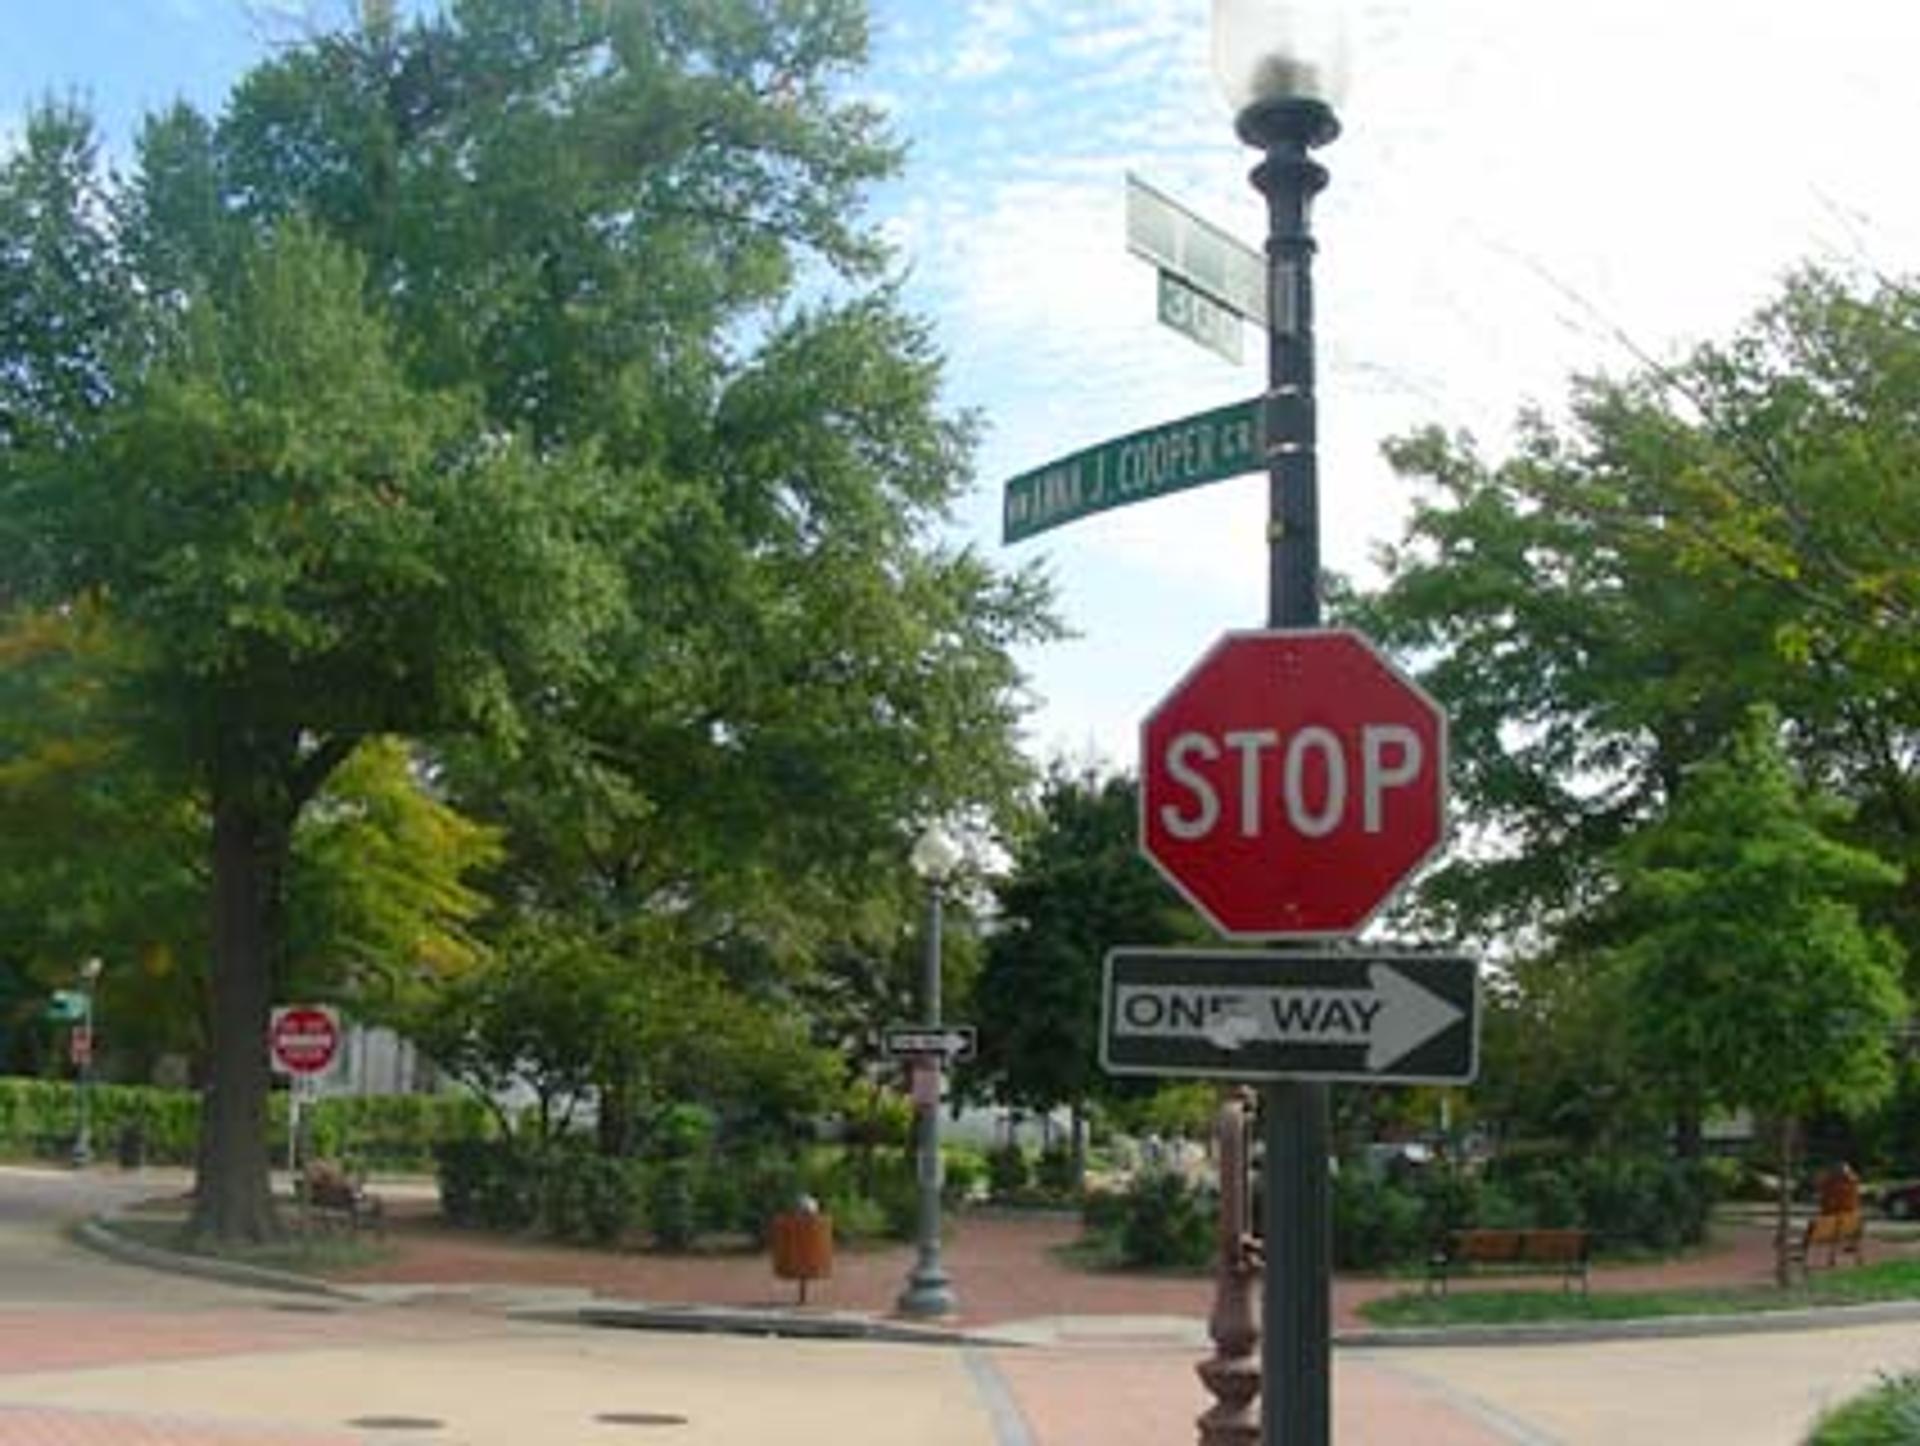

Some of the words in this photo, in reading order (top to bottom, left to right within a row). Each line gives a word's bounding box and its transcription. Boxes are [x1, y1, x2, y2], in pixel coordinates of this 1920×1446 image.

[1117, 423, 1215, 494] COOPER
[1161, 726, 1422, 837] STOP
[1271, 997, 1381, 1034] WAY
